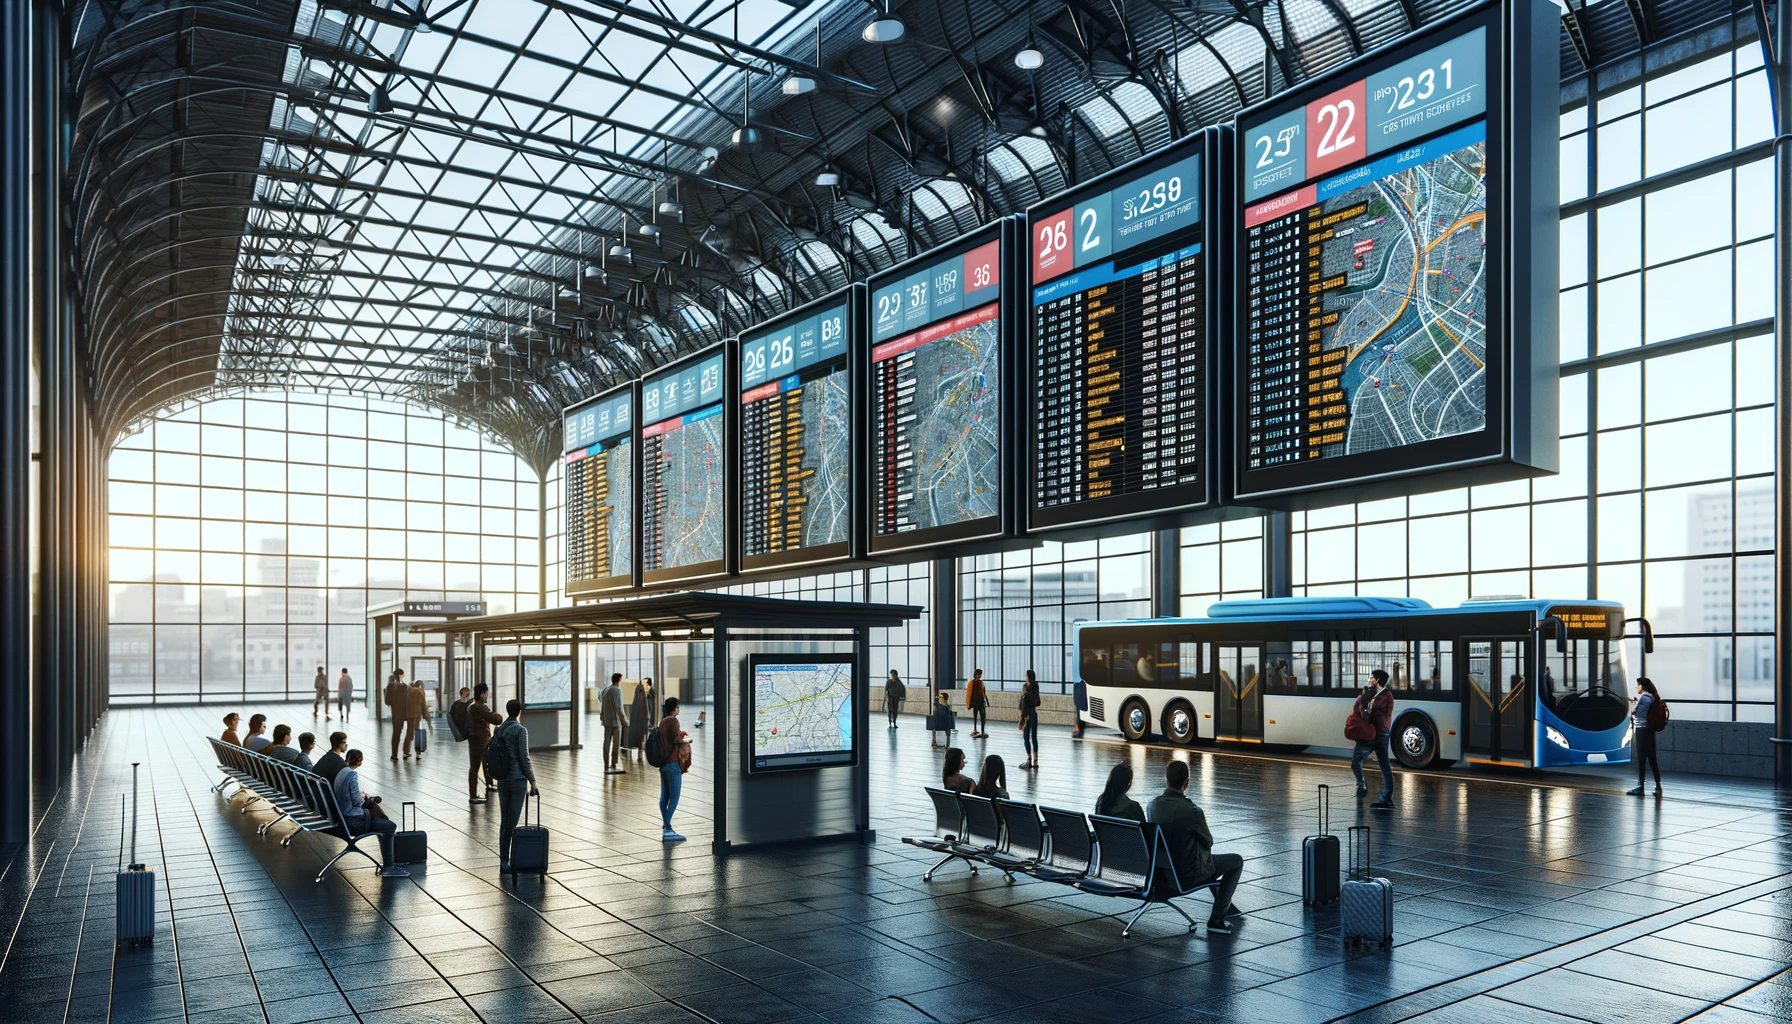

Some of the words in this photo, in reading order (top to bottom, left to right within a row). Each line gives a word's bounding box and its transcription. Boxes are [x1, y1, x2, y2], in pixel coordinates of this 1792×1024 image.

[1316, 99, 1356, 158] 22
[1039, 219, 1067, 259] 26
[1080, 208, 1100, 252] 2
[973, 263, 990, 287] 36
[770, 335, 794, 369] 26
